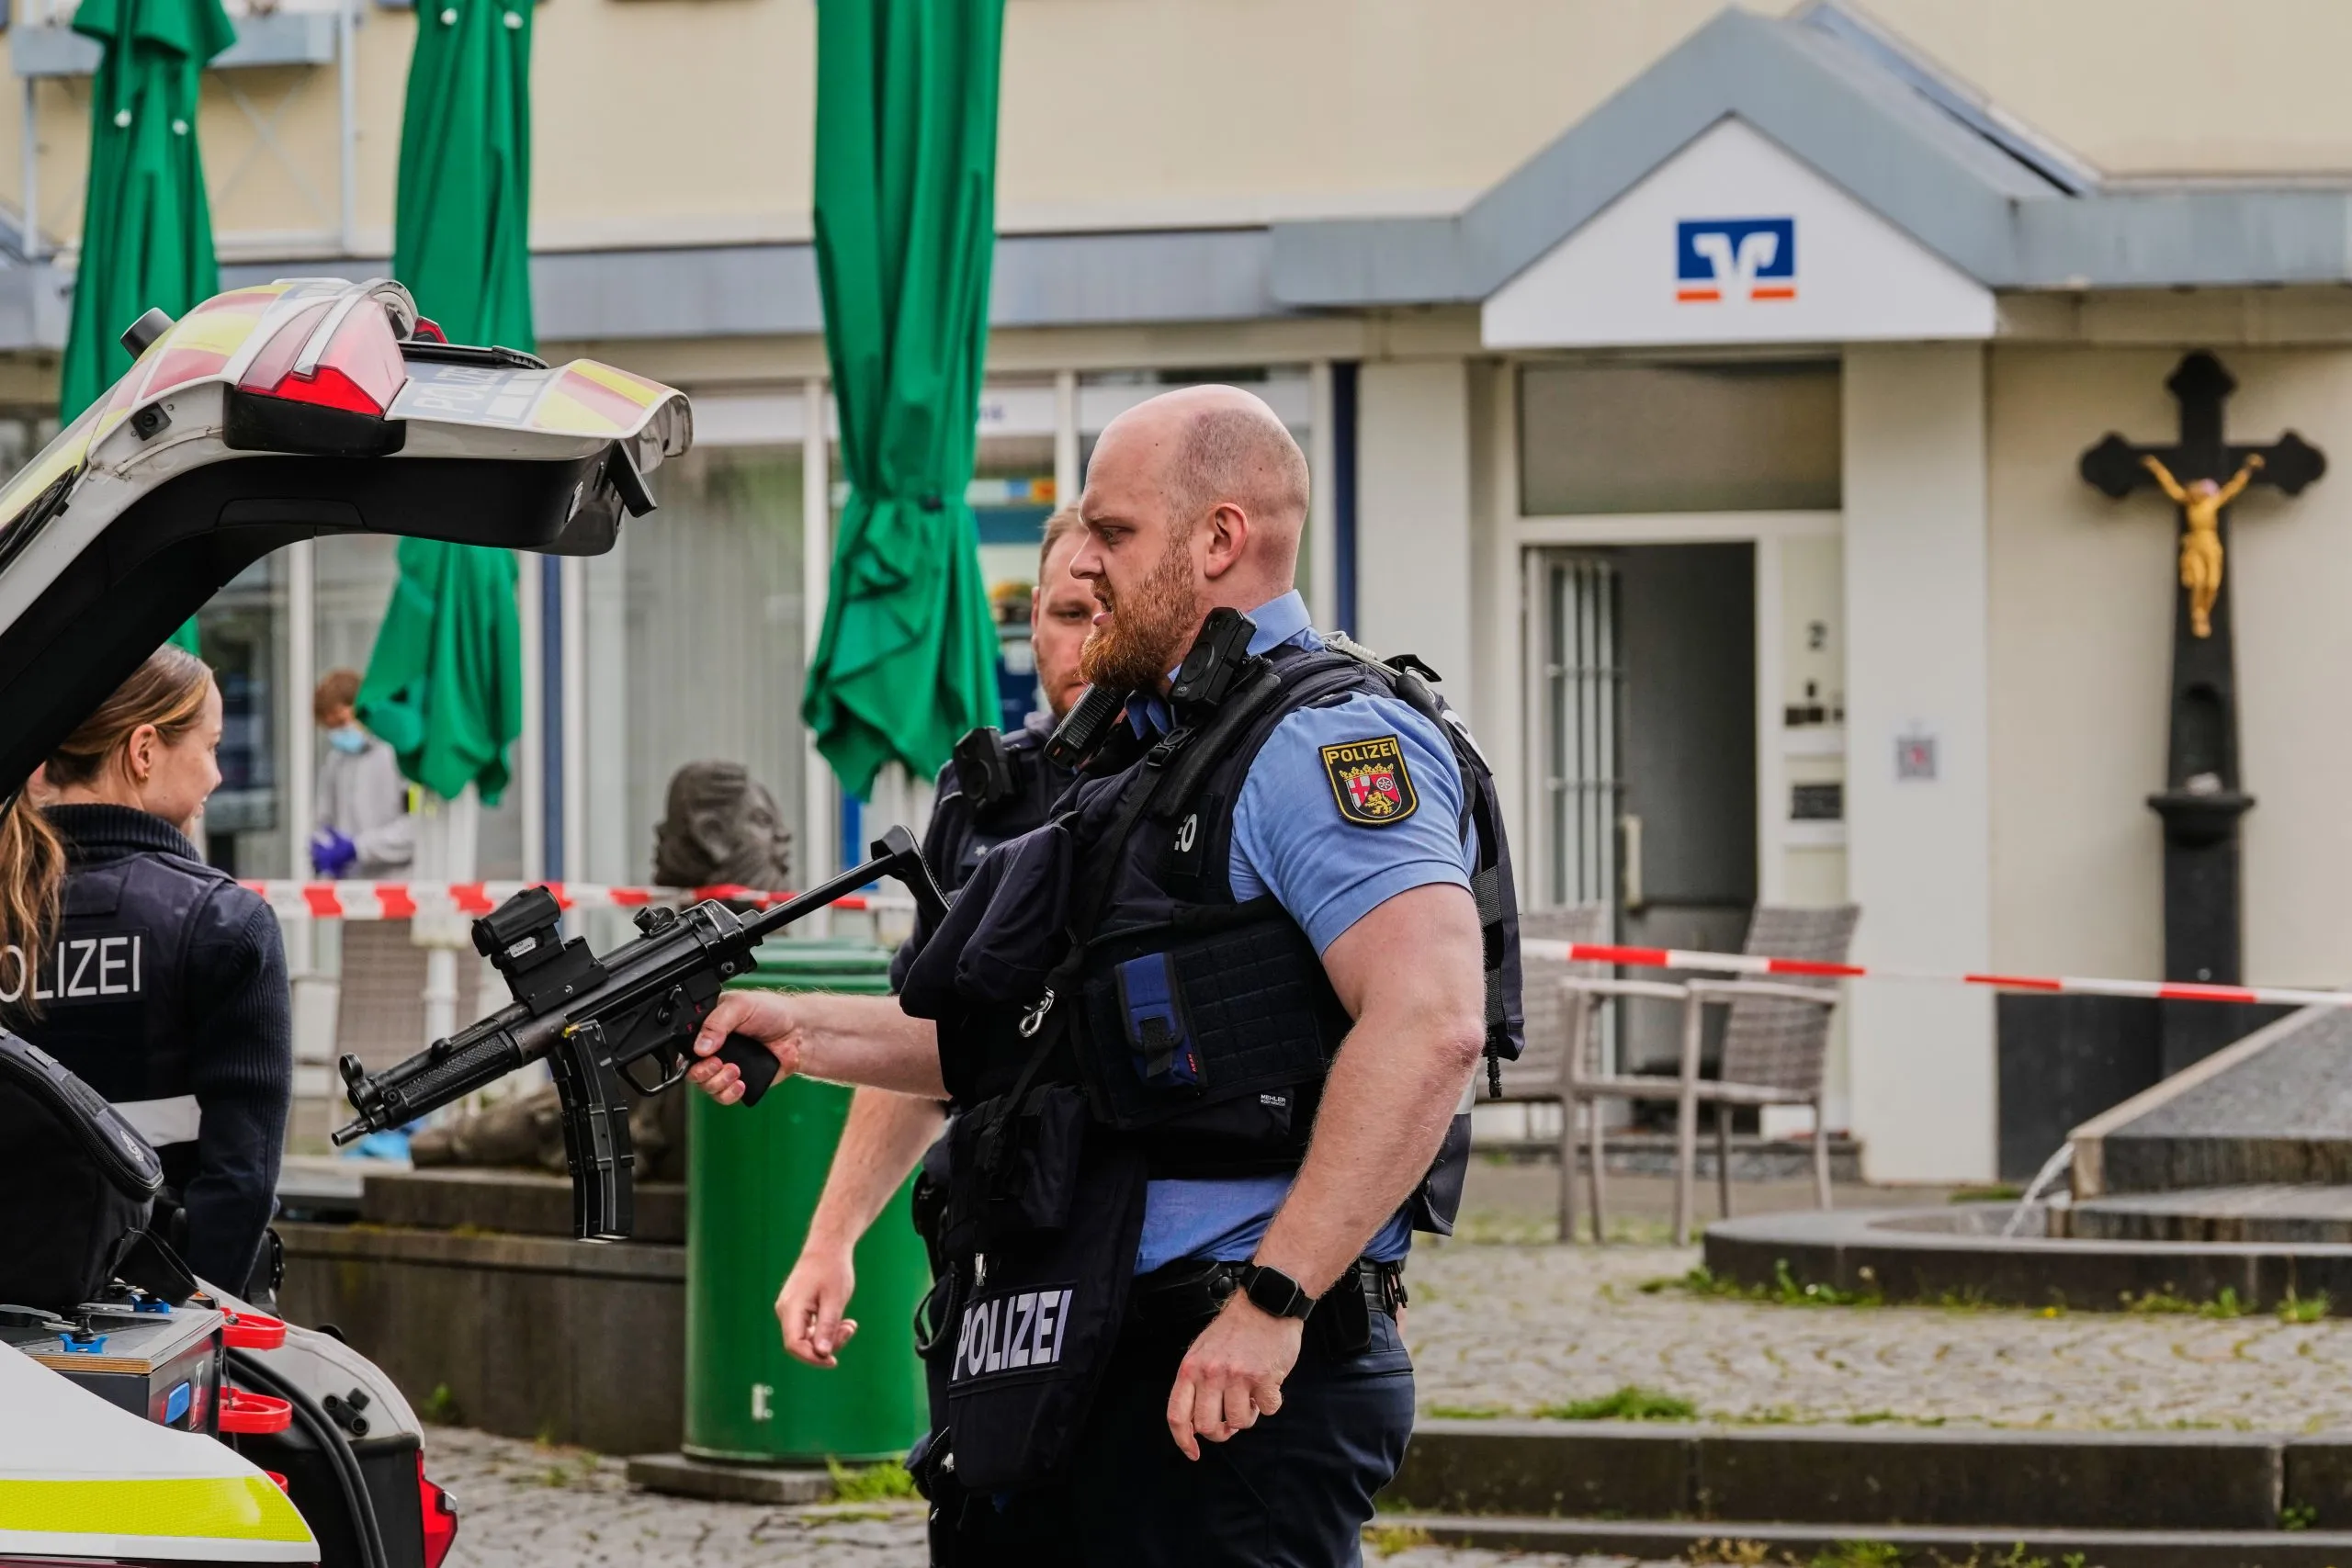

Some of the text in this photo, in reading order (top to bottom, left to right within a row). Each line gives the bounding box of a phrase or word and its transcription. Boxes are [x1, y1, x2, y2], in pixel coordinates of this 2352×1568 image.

[413, 365, 505, 414] POLIZE
[1327, 741, 1396, 765] POLIZEI
[0, 935, 141, 1003] OLIZEI
[1261, 1093, 1286, 1103] MEHLER
[952, 1289, 1073, 1382] POLIZEI
